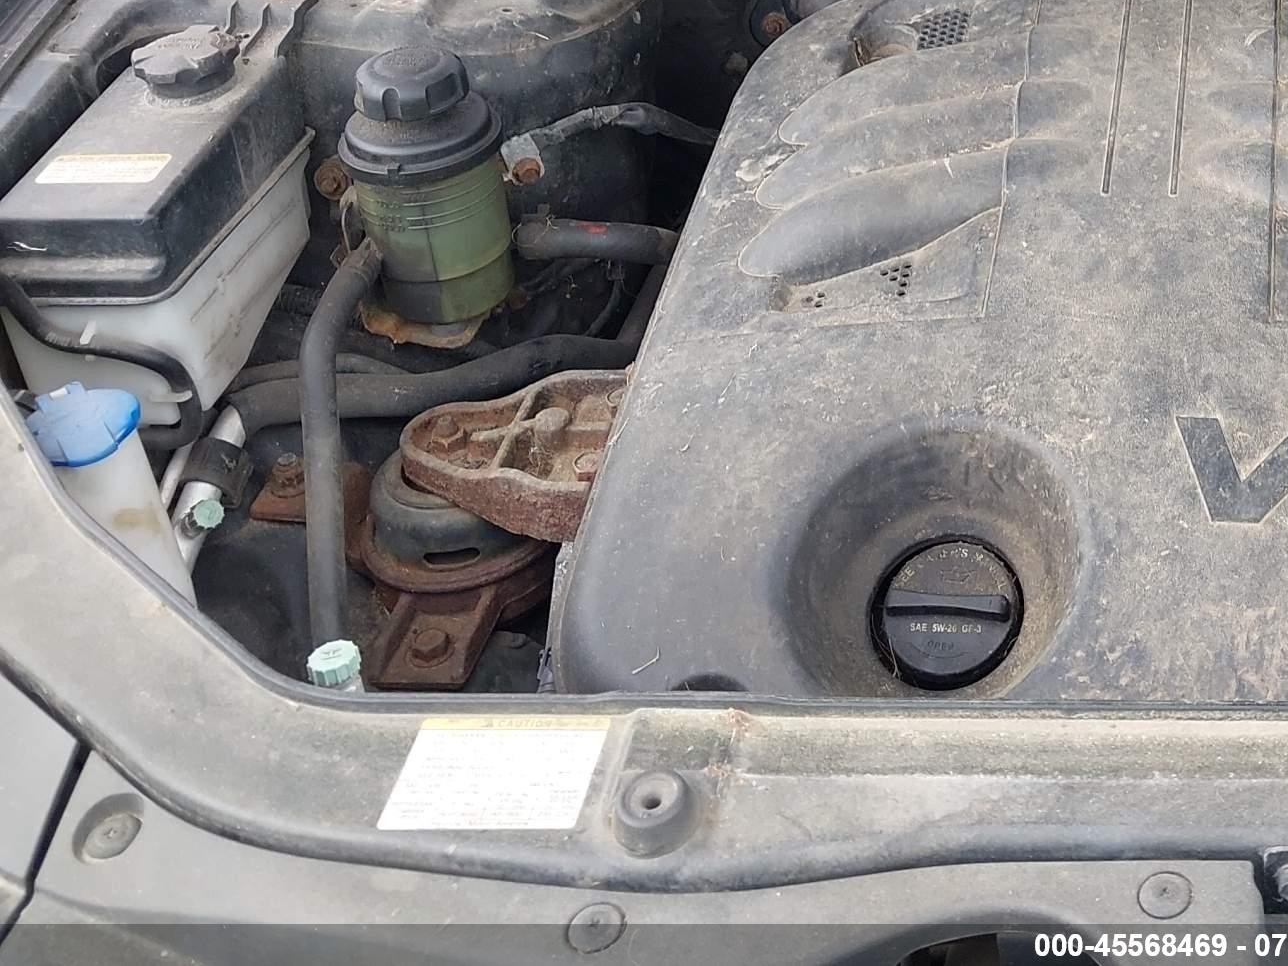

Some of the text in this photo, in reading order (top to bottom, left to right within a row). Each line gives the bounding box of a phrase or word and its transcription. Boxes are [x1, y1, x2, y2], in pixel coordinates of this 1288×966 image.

[910, 622, 927, 633] SAE
[932, 622, 957, 634] 5W-20
[498, 719, 553, 728] CAUTION
